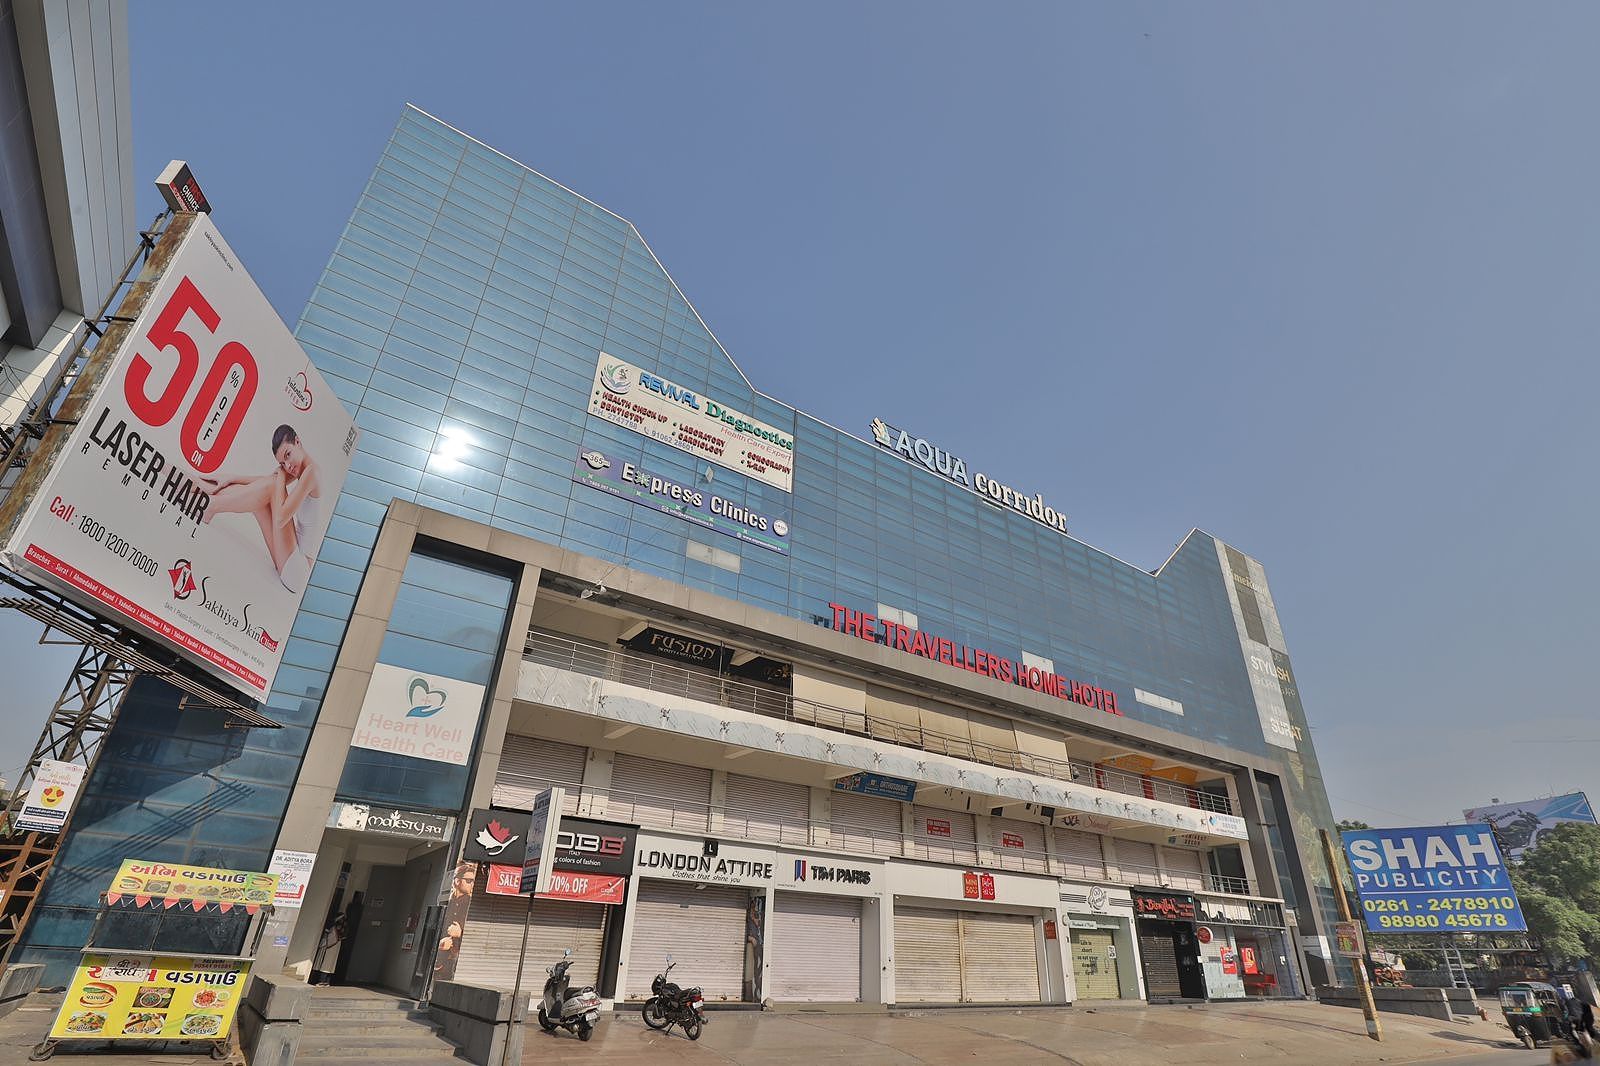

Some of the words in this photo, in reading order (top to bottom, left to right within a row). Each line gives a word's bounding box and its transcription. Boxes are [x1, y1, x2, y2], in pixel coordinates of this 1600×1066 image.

[182, 184, 200, 212] CHOICE
[123, 275, 259, 473] 50
[231, 370, 239, 388] %
[203, 396, 228, 441] OFF
[600, 401, 645, 424] DENTISTRY
[602, 391, 631, 409] HEALTH
[632, 404, 658, 420] CHECK
[657, 414, 669, 424] UP
[639, 372, 700, 410] REVIVAL
[705, 401, 794, 451] Diagnostics
[678, 432, 725, 457] CARDIOLOGY
[679, 423, 726, 448] LABORATORY
[721, 427, 746, 441] Health
[747, 437, 766, 449] Care
[766, 445, 792, 460] Expert
[89, 406, 166, 489] LASER
[159, 465, 211, 526] HAIR
[191, 450, 204, 467] ON
[589, 454, 603, 464] 365
[747, 451, 792, 475] SONOGRAPHY
[81, 441, 197, 539] REMOVAL
[895, 430, 970, 486] AQUA
[974, 472, 1067, 534] corridor
[710, 496, 768, 531] Clinics
[49, 495, 74, 523] Call
[78, 515, 106, 542] 1800
[104, 532, 130, 558] 1200
[128, 546, 159, 577] 70000
[198, 576, 240, 629] Sakhiya
[240, 603, 262, 642] Skin
[651, 633, 716, 660] FUSION
[829, 602, 876, 643] THE
[880, 619, 1014, 684] TRAVELLERS
[1016, 662, 1069, 701] HOME
[1070, 680, 1124, 718] HOTEL
[367, 713, 419, 736] Heart
[424, 721, 463, 743] Well
[355, 730, 416, 753] Health
[421, 741, 464, 762] Care
[583, 859, 601, 867] fashion
[637, 850, 711, 873] LONDON
[715, 858, 773, 880] ATTIRE
[1350, 833, 1500, 871] SHAH
[498, 873, 520, 888] SALE
[549, 875, 571, 891] 70%
[571, 877, 589, 894] OFF
[672, 870, 695, 880] Clothes
[696, 871, 711, 881] that
[712, 873, 730, 882] shine
[730, 876, 742, 884] you
[811, 865, 835, 882] TIM
[836, 868, 872, 885] PARIS
[1357, 868, 1499, 888] PUBLICITY
[1364, 899, 1410, 912] 0261
[1428, 896, 1514, 911] 2478910
[1379, 914, 1440, 928] 98980
[1445, 914, 1508, 927] 45678
